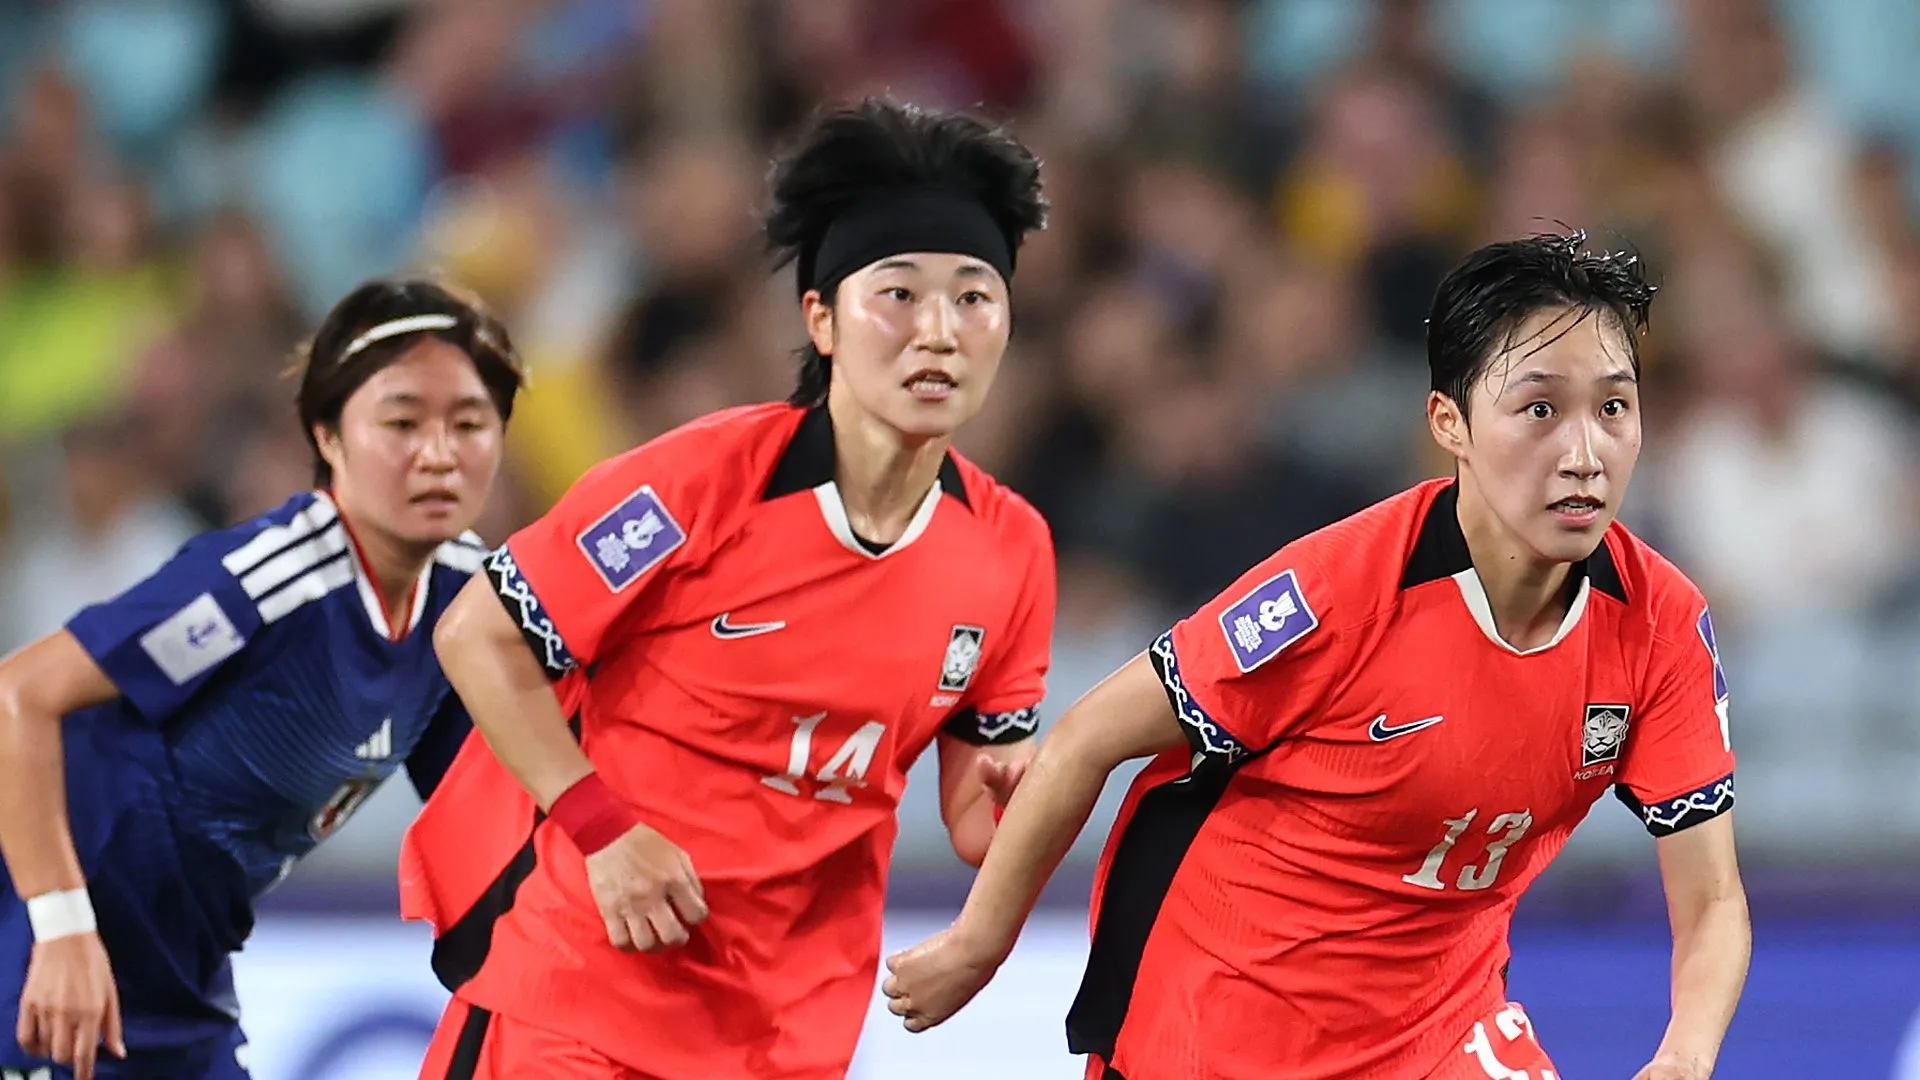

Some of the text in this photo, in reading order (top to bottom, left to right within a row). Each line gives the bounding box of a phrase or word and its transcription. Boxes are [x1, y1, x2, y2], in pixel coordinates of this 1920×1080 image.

[760, 710, 887, 804] 14
[1573, 764, 1615, 780] KOREA
[1402, 808, 1533, 890] 13
